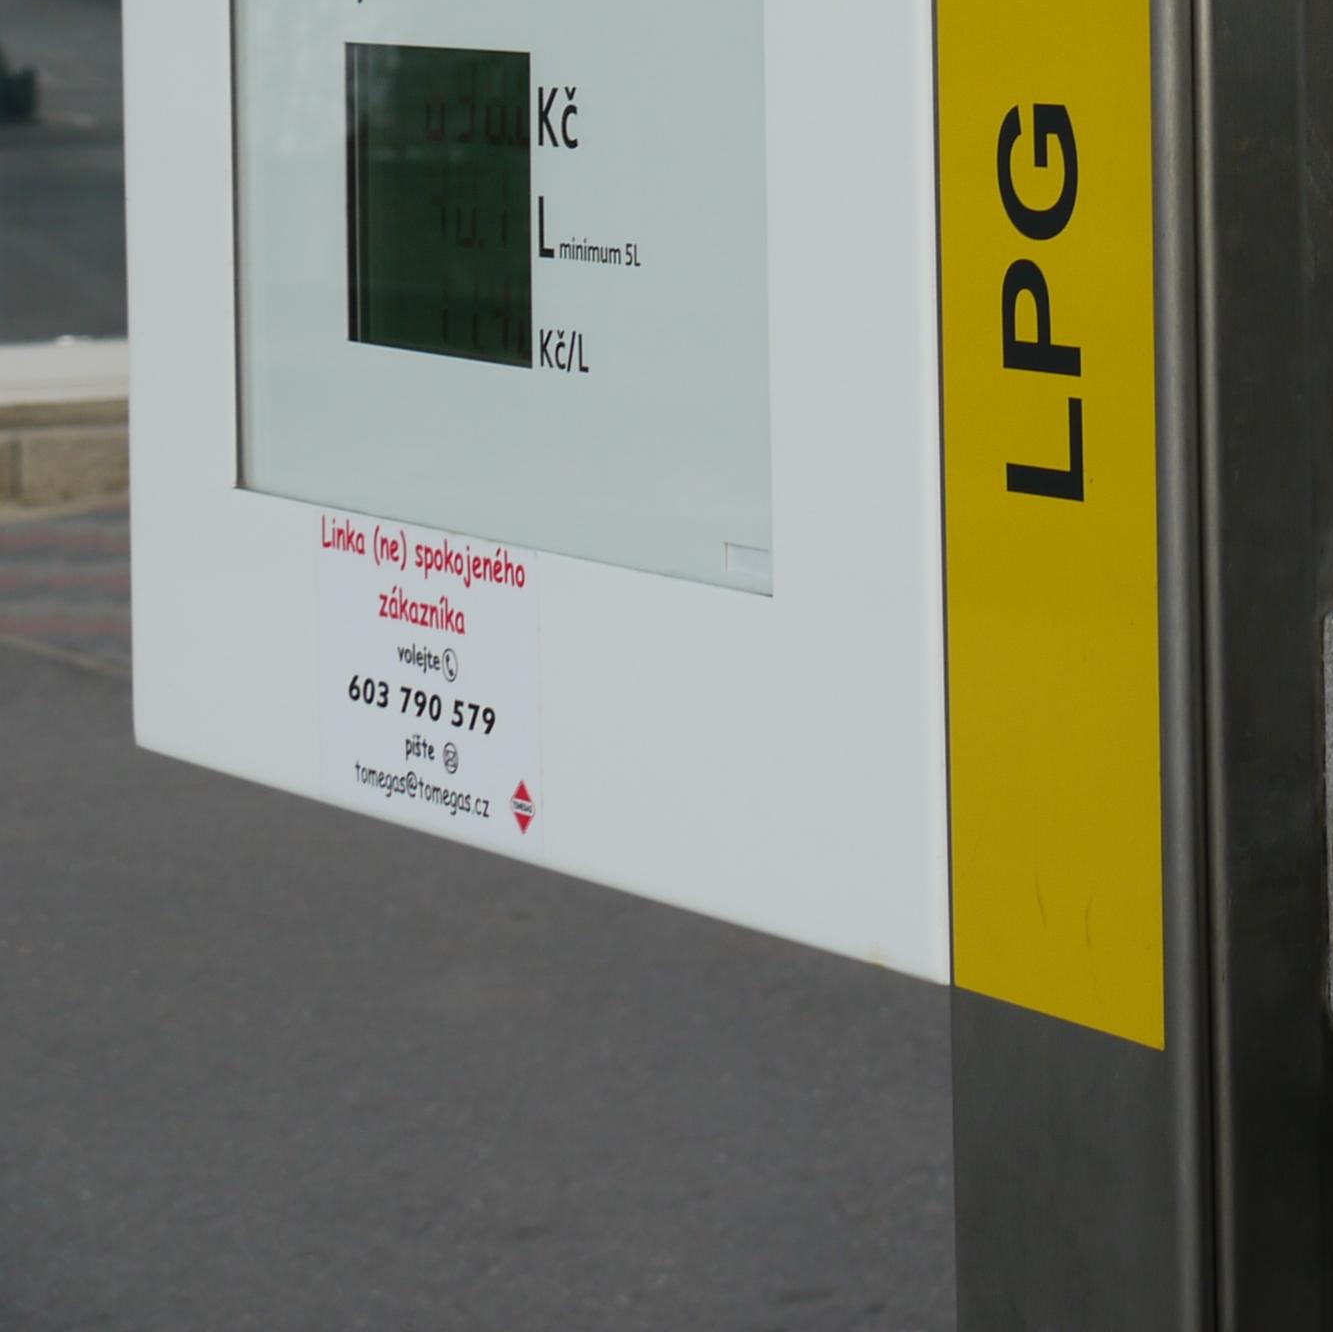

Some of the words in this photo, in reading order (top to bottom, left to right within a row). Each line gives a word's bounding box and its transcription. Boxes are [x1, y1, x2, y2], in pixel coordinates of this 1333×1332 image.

[537, 86, 578, 150] Kč
[538, 196, 554, 259] L
[559, 237, 621, 266] minimum
[625, 243, 641, 268] 5L
[996, 102, 1085, 503] LPG
[540, 329, 590, 373] Kč/L
[321, 515, 366, 556] Linka
[373, 524, 407, 572] (ne)
[415, 538, 526, 589] spokojeného
[379, 584, 466, 635] zákazníka
[396, 643, 441, 674] volejte
[347, 674, 390, 709] 603
[400, 685, 442, 722] 790
[451, 699, 497, 736] 579
[354, 760, 490, 819] tomegas@tomegas.cz
